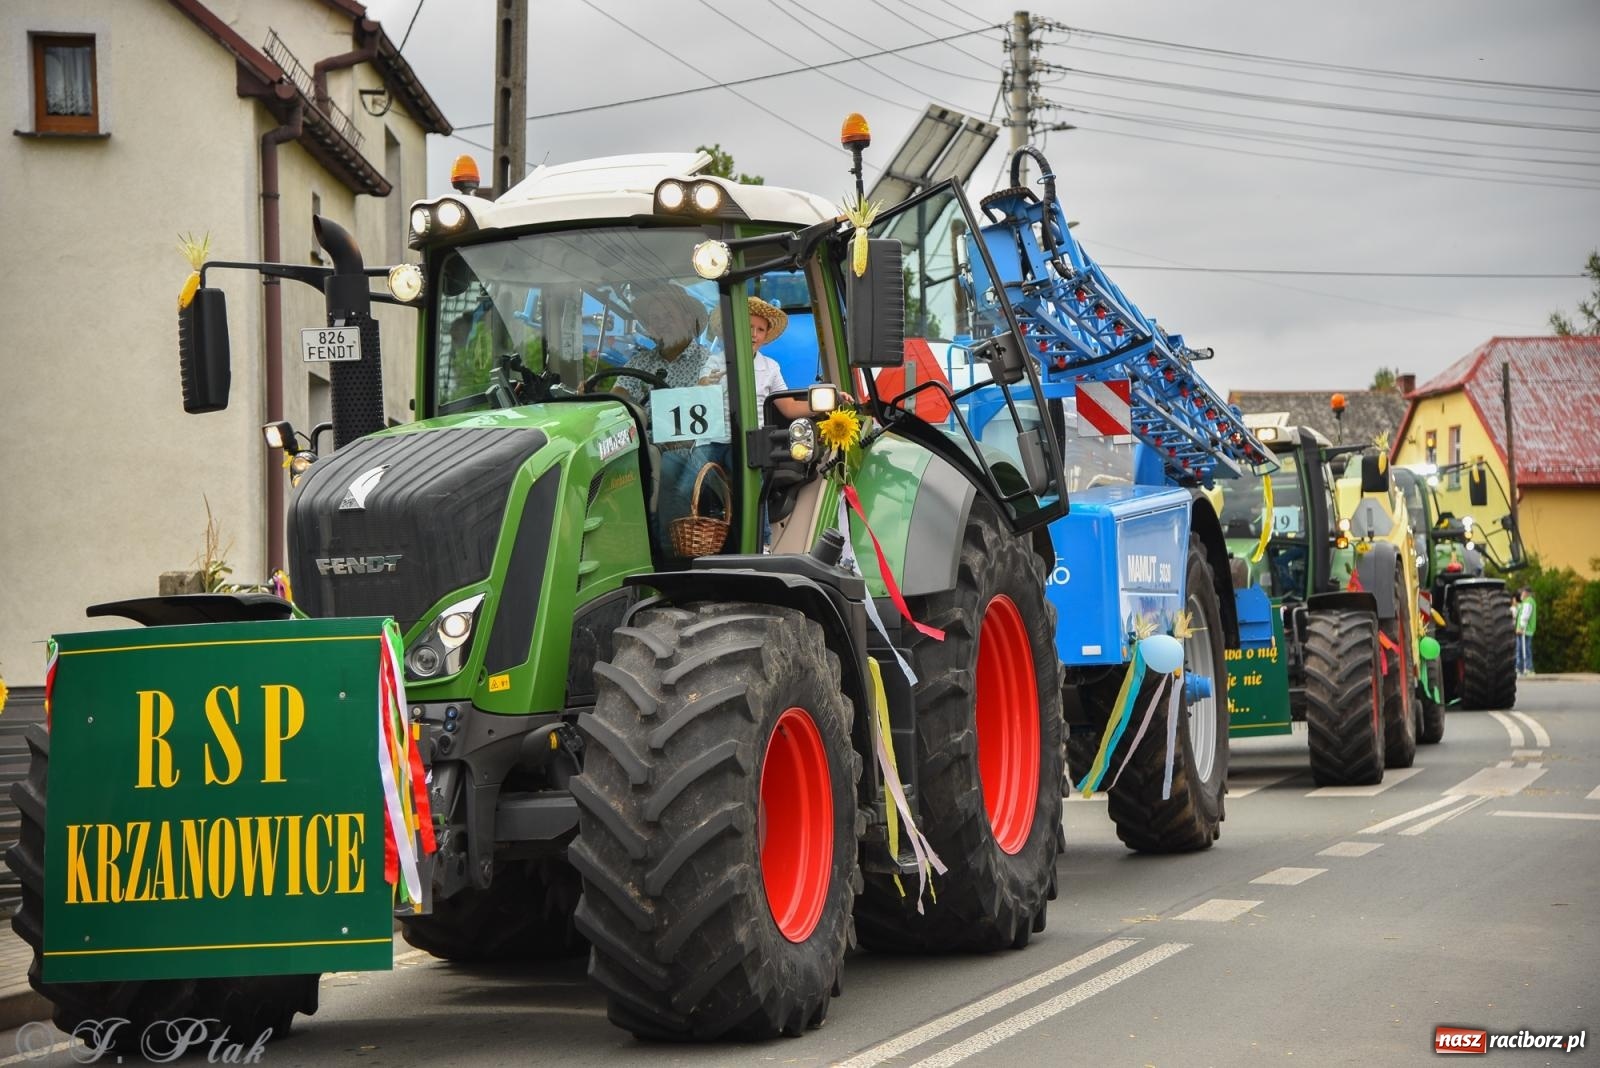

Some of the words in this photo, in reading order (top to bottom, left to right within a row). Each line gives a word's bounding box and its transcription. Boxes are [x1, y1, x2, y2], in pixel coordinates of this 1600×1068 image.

[319, 331, 345, 345] 826
[308, 345, 355, 360] FENDT
[668, 404, 709, 437] 18
[315, 554, 404, 576] FENDT
[1127, 554, 1157, 583] MAMUT
[1246, 648, 1255, 660] o
[1243, 670, 1263, 687] nie
[64, 812, 366, 905] KRZANOWICE
